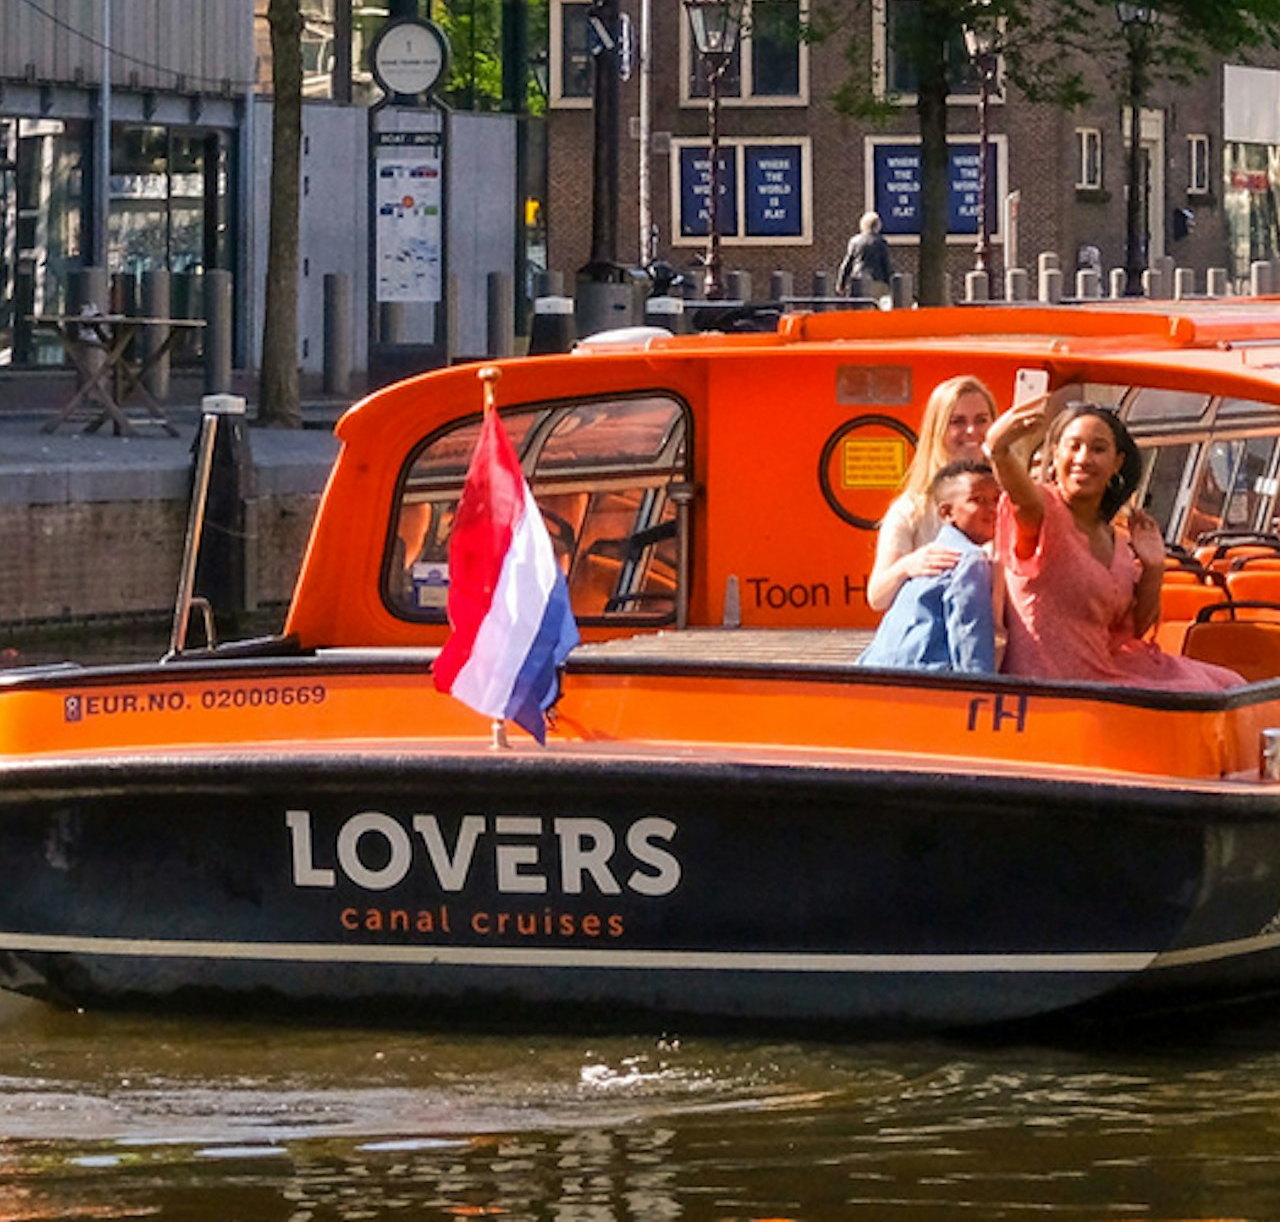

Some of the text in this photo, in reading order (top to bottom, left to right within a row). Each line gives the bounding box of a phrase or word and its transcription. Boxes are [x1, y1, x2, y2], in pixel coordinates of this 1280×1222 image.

[757, 160, 791, 170] WHERE
[886, 158, 919, 168] WHERE
[764, 171, 784, 182] THE
[893, 169, 913, 179] THE
[757, 184, 792, 194] WORLD
[886, 182, 921, 192] WORLD
[769, 196, 779, 207] IS
[763, 209, 786, 219] FLAT
[892, 207, 915, 216] FLAT
[745, 577, 830, 610] Toon
[85, 691, 193, 716] EUR.NO.
[285, 809, 682, 897] LOVERS
[340, 904, 625, 938] canal cruises
